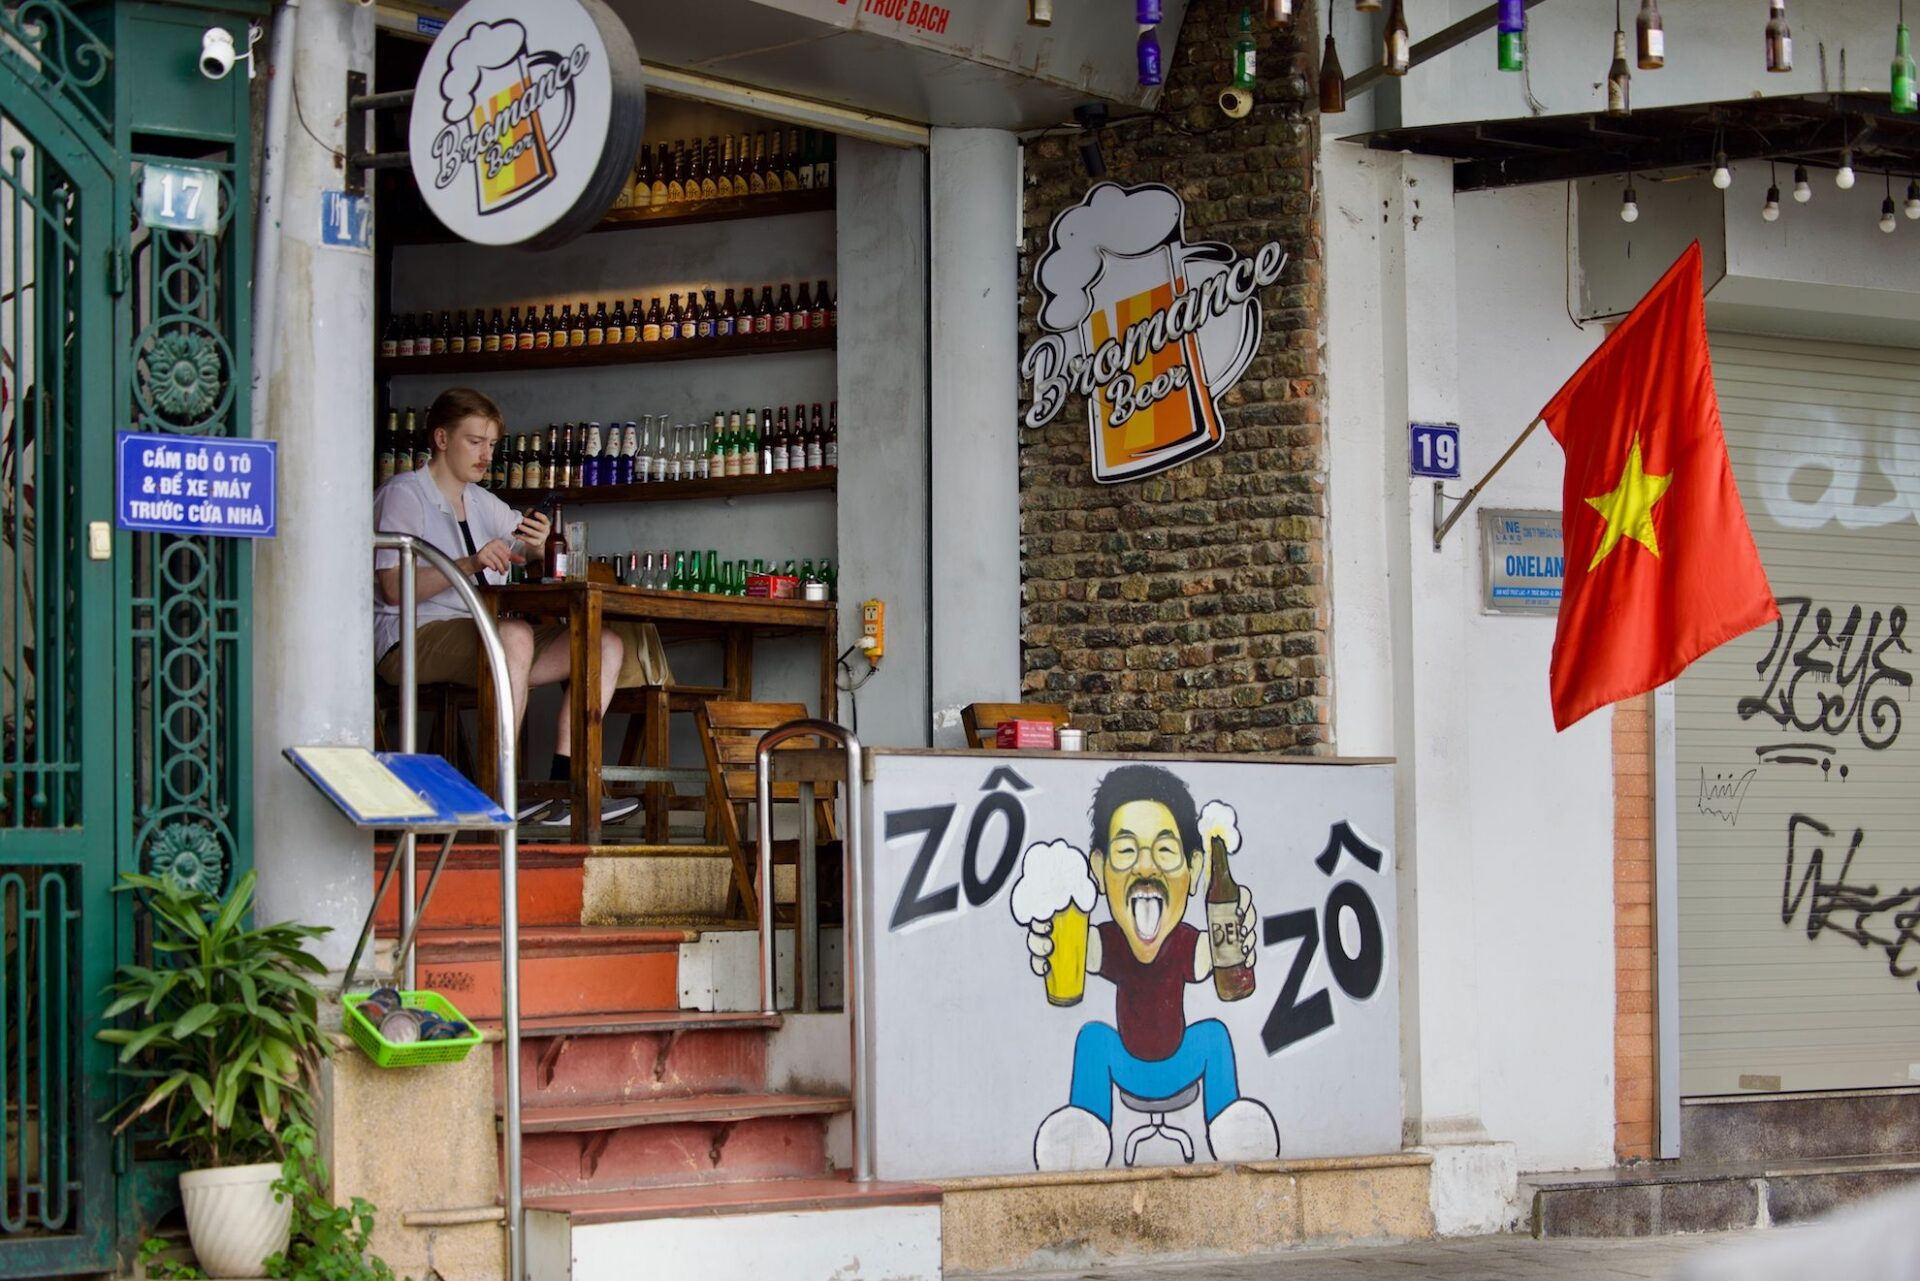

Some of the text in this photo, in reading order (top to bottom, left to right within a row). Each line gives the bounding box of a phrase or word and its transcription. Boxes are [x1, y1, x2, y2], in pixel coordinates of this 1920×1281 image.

[906, 1, 950, 34] BẠCH
[431, 43, 590, 189] Bromance
[485, 132, 536, 179] Beer
[160, 173, 203, 220] 17
[1021, 240, 1289, 428] Bromance
[1106, 364, 1190, 427] Beer
[142, 445, 251, 473] CẤM ĐỖ Ô TÔ
[1417, 433, 1457, 470] 19
[142, 471, 252, 499] & ĐỂ XE MÁY
[130, 499, 264, 526] TRƯỚC CỬA NHÀ
[883, 763, 1034, 933] ZÔ
[1261, 819, 1384, 1058] ZÔ
